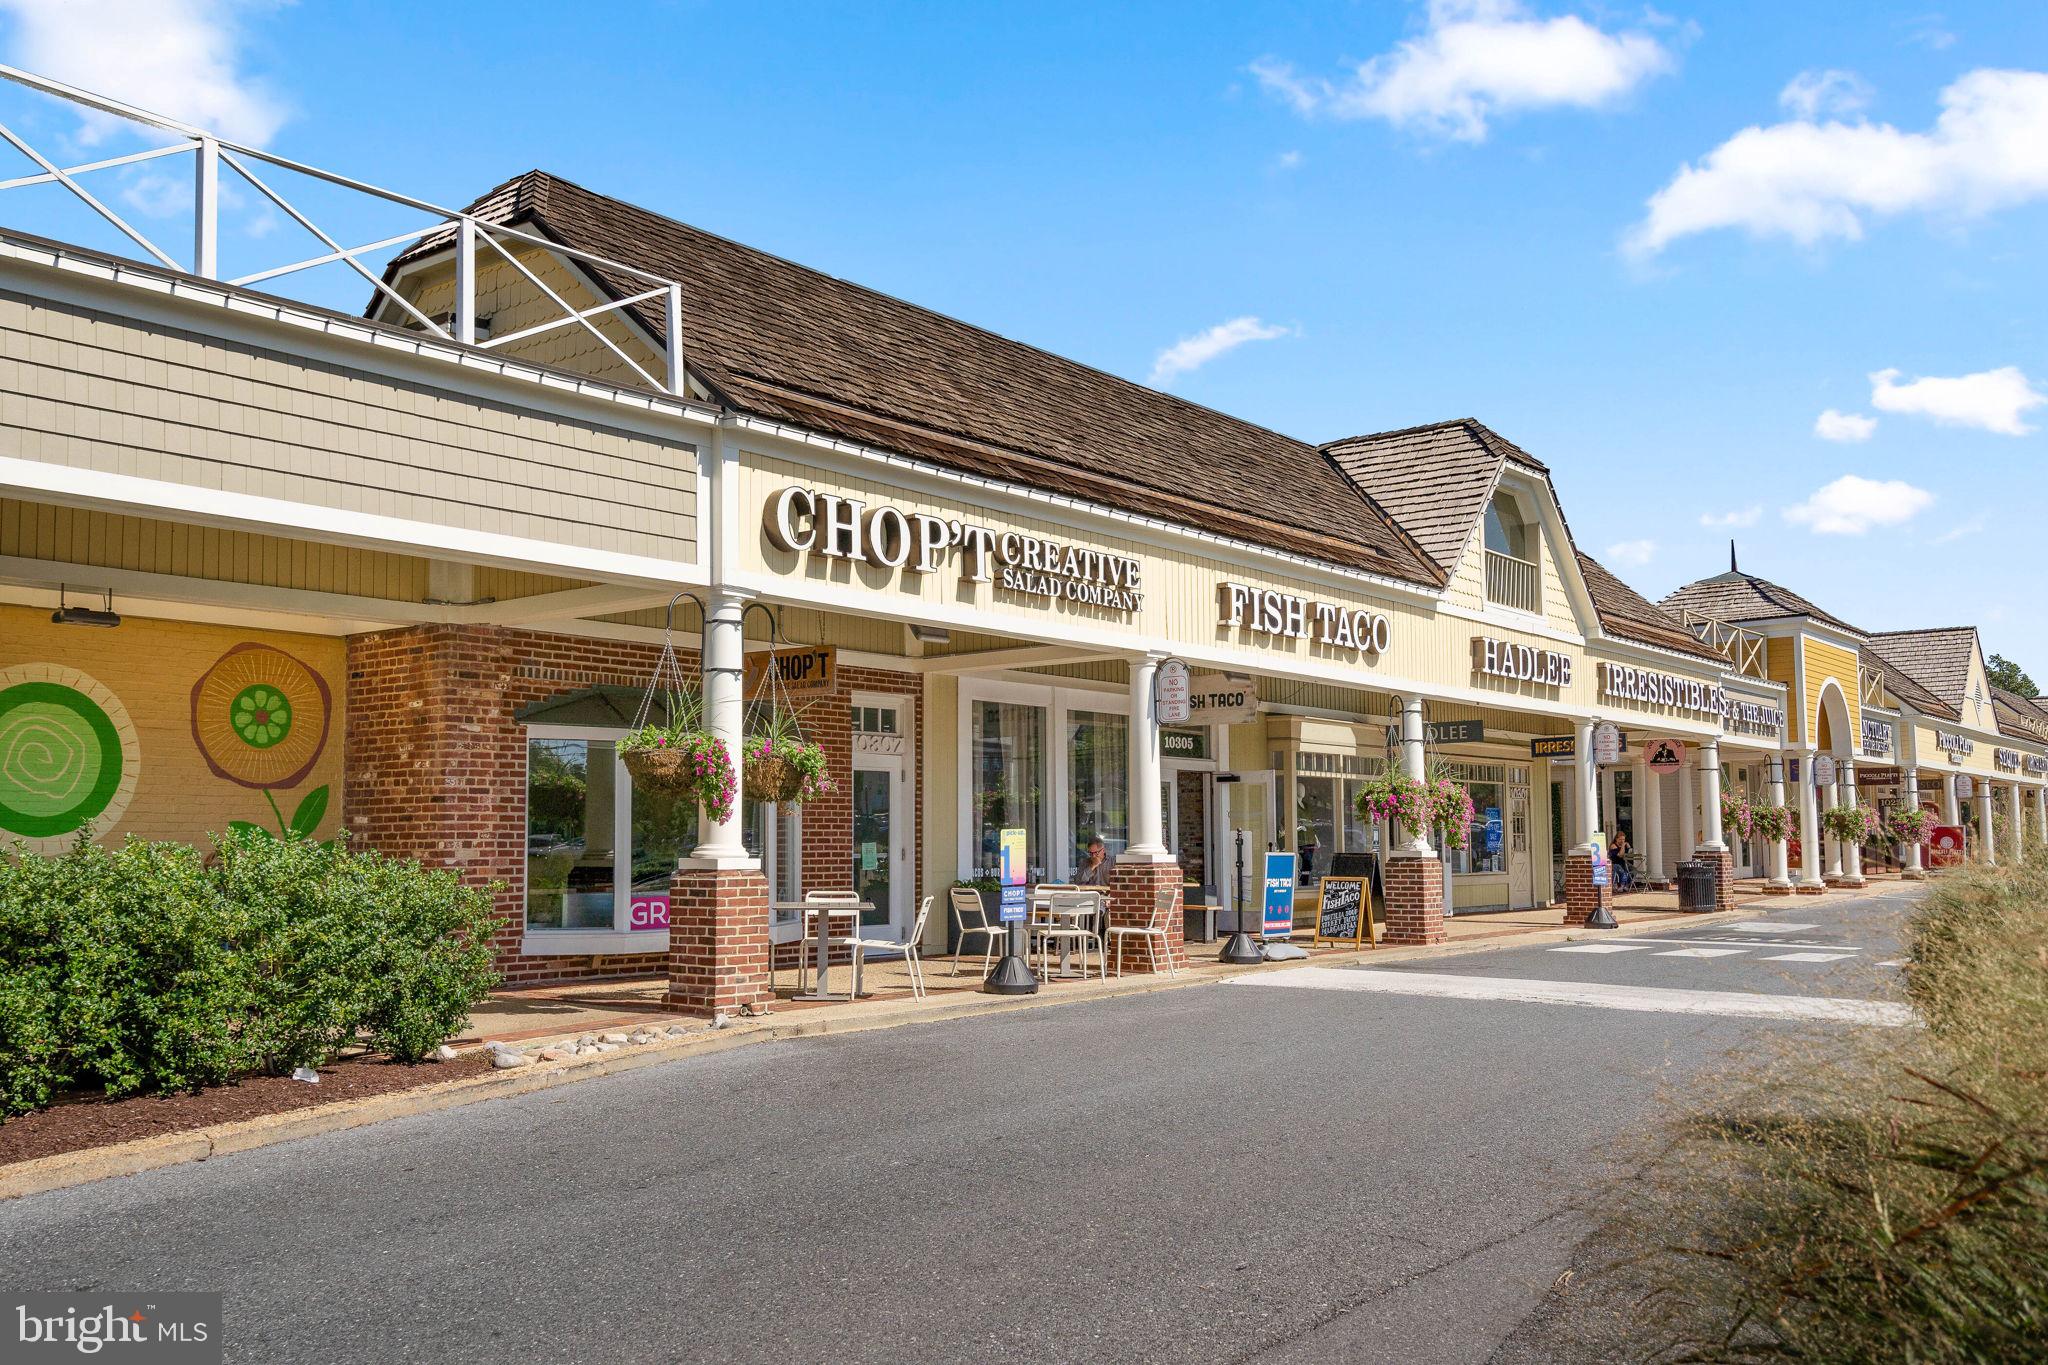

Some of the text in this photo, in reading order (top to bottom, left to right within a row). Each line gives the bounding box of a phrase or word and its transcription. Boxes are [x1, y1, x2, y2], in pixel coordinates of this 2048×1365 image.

[772, 486, 1142, 589] CHOP'T CREATIVE
[1003, 568, 1145, 613] SALAD COMPANY
[1224, 584, 1391, 655] FISH TACO
[1480, 636, 1573, 688] HADLEE
[1190, 692, 1244, 709] SH TACO
[1602, 663, 1727, 715] IRRESISTIBLES
[1741, 702, 1760, 723] THE
[1760, 706, 1785, 728] JUICE
[1427, 725, 1468, 740] DLEE
[1862, 719, 1890, 741] NCTUARY
[1164, 736, 1194, 750] 10305
[1535, 740, 1576, 754] IRRES
[1001, 845, 1013, 885] 1
[1591, 843, 1601, 866] 3
[1267, 878, 1292, 888] FISH TACO
[1325, 881, 1361, 890] WELCOME
[630, 902, 670, 925] GR
